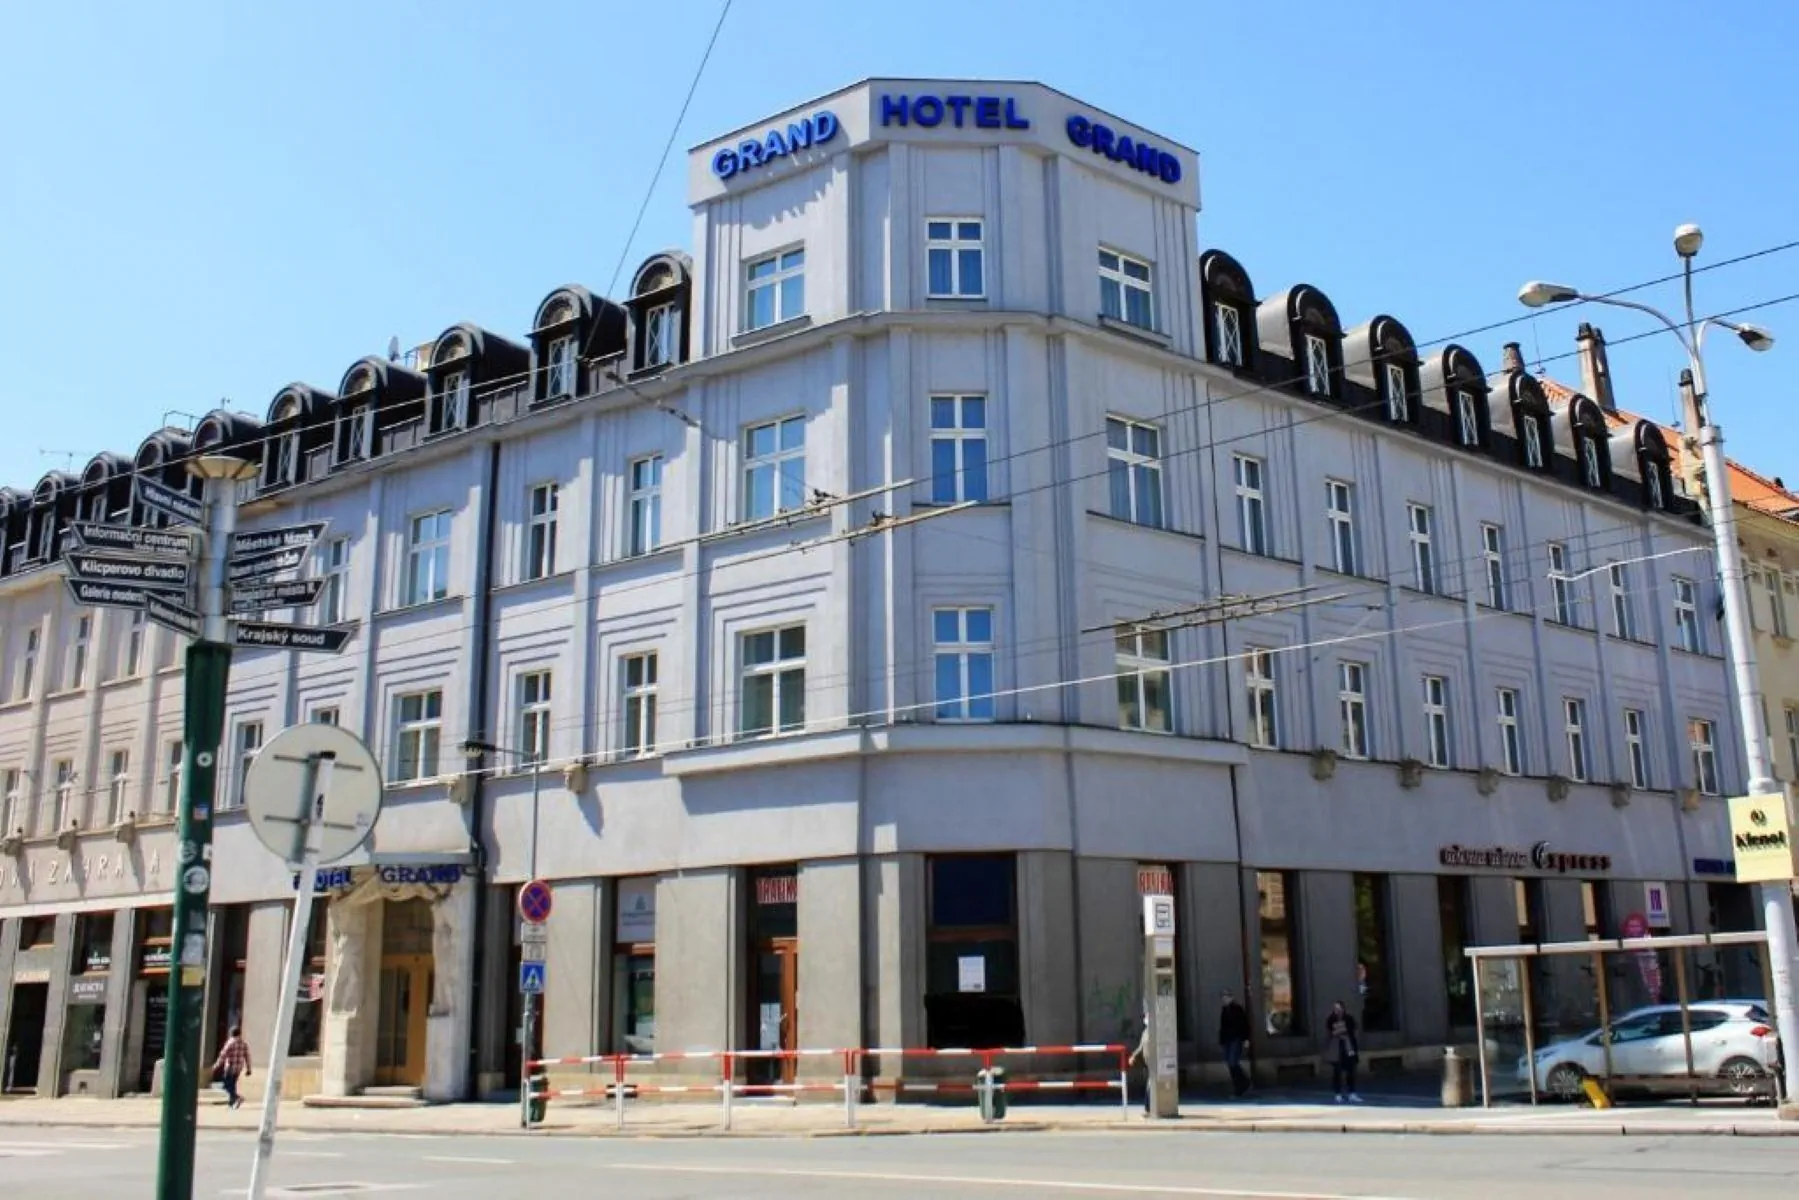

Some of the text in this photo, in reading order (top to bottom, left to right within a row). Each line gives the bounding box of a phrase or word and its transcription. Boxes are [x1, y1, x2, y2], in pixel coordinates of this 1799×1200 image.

[882, 95, 1030, 129] HOTEL
[711, 110, 838, 180] GRAND
[1067, 114, 1182, 185] GRAND
[144, 533, 189, 548] centrum
[81, 559, 185, 578] Klicperovo divadlo
[237, 628, 326, 645] Krajský soud
